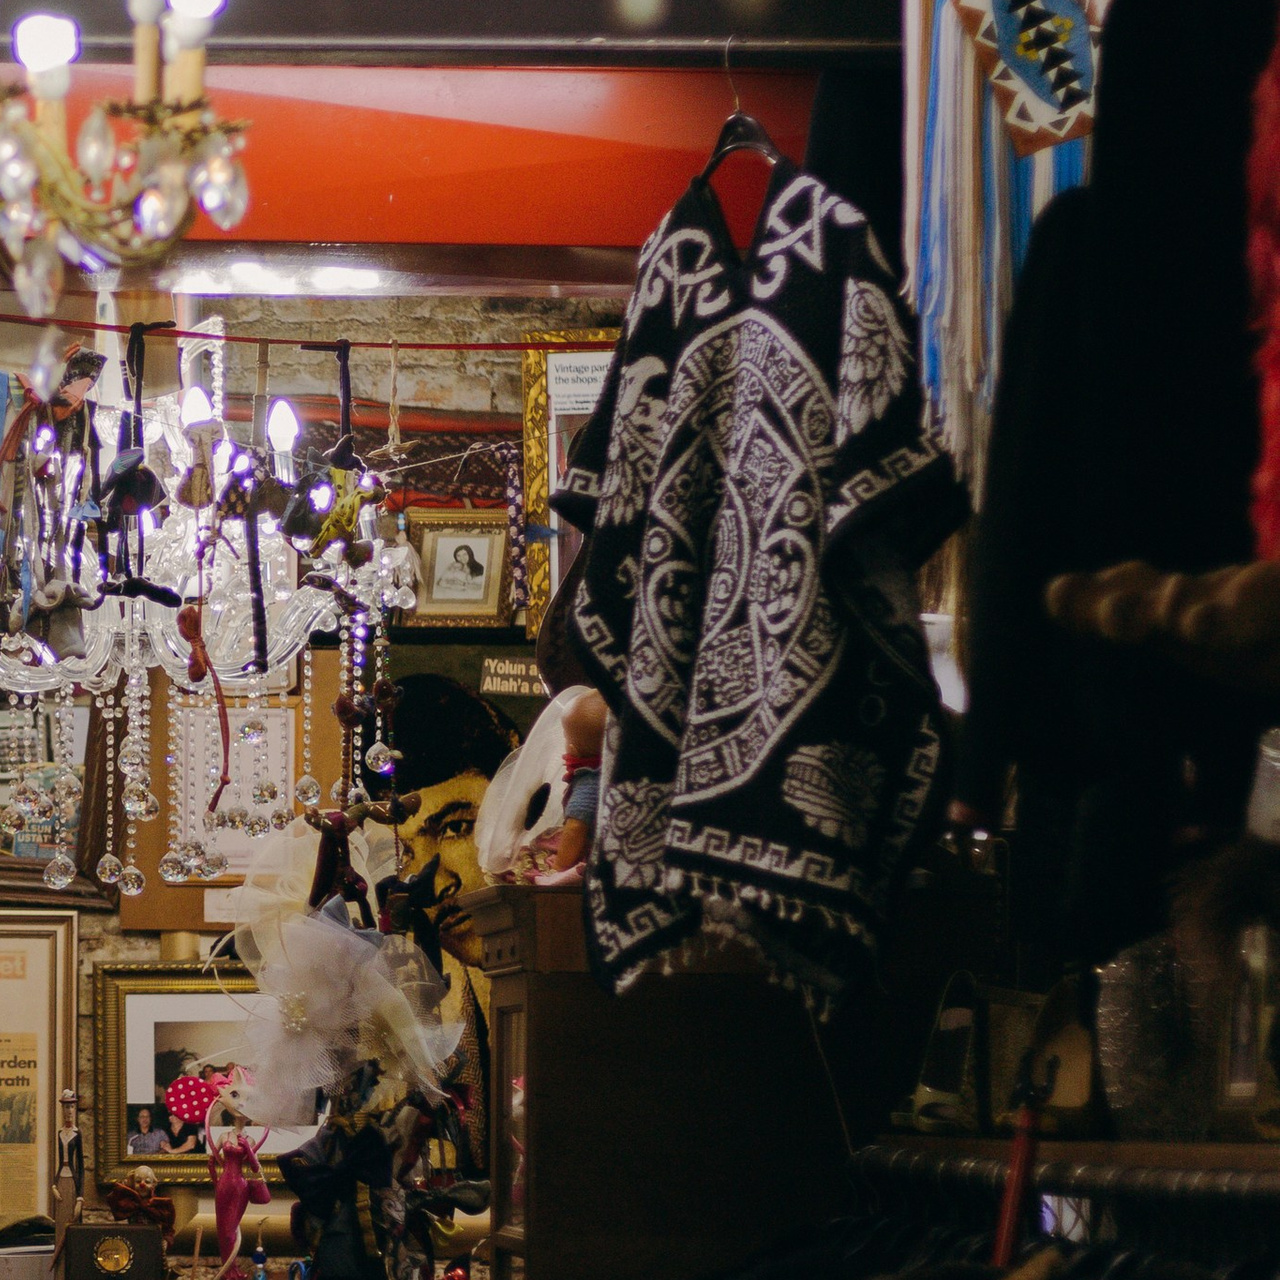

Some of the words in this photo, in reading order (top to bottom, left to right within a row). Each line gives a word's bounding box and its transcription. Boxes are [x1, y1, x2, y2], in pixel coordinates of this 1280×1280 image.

[554, 363, 589, 374] Vintage
[554, 376, 570, 384] the
[483, 675, 530, 695] Allah'a
